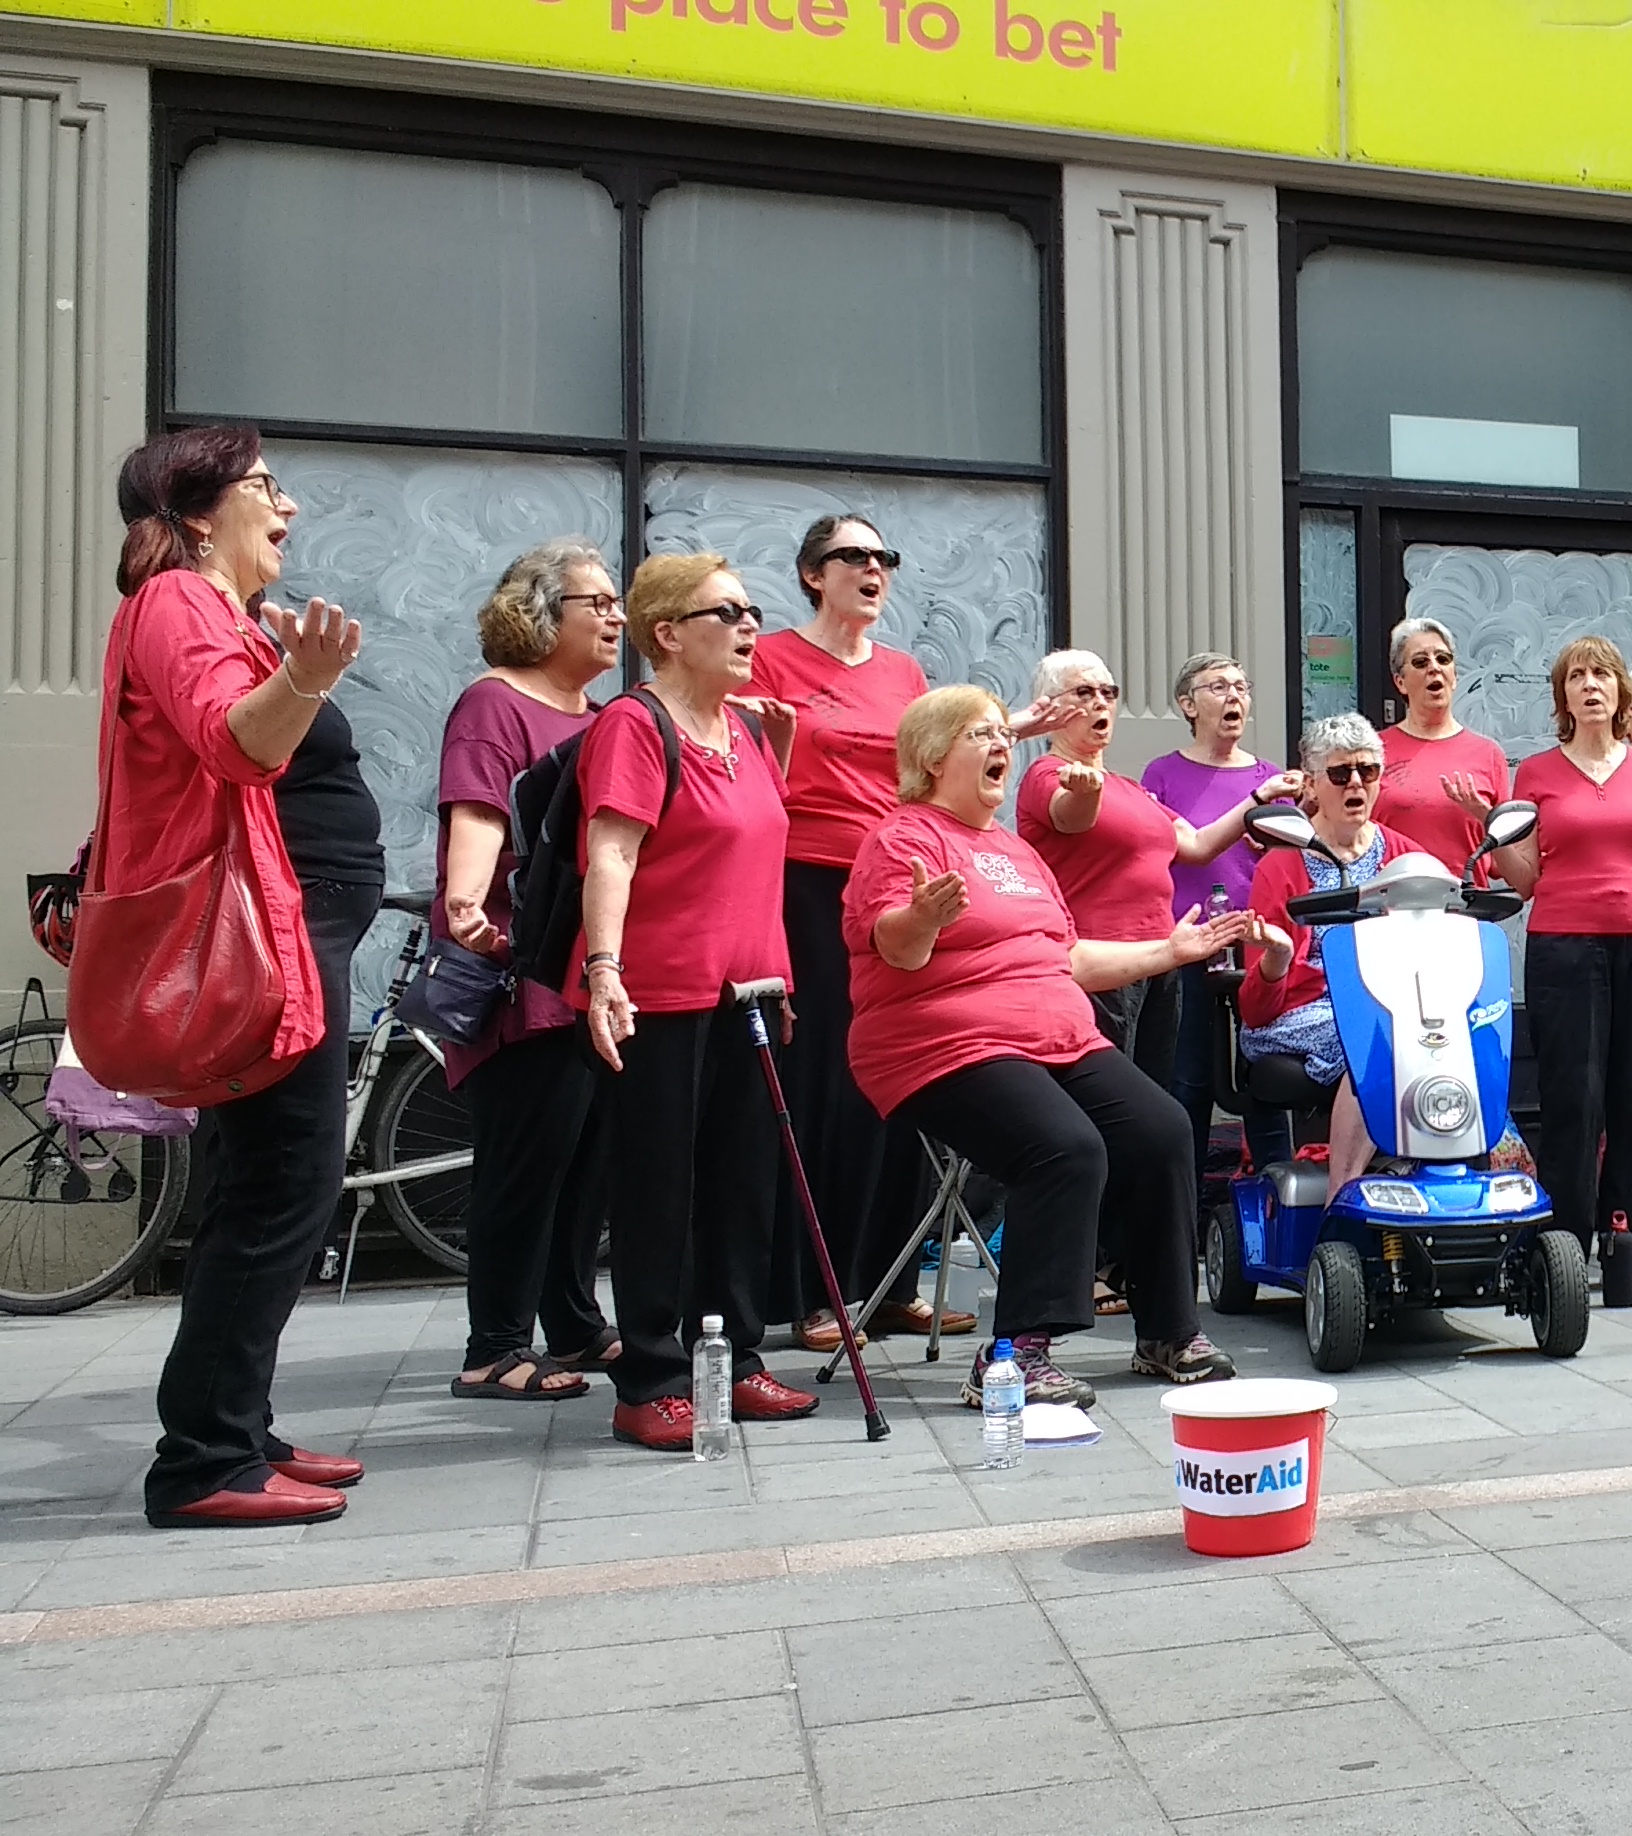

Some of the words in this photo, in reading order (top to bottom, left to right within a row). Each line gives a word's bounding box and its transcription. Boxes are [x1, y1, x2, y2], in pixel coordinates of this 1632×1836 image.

[880, 0, 961, 52] to
[994, 0, 1122, 72] bet
[1181, 1457, 1303, 1495] WaterAid
